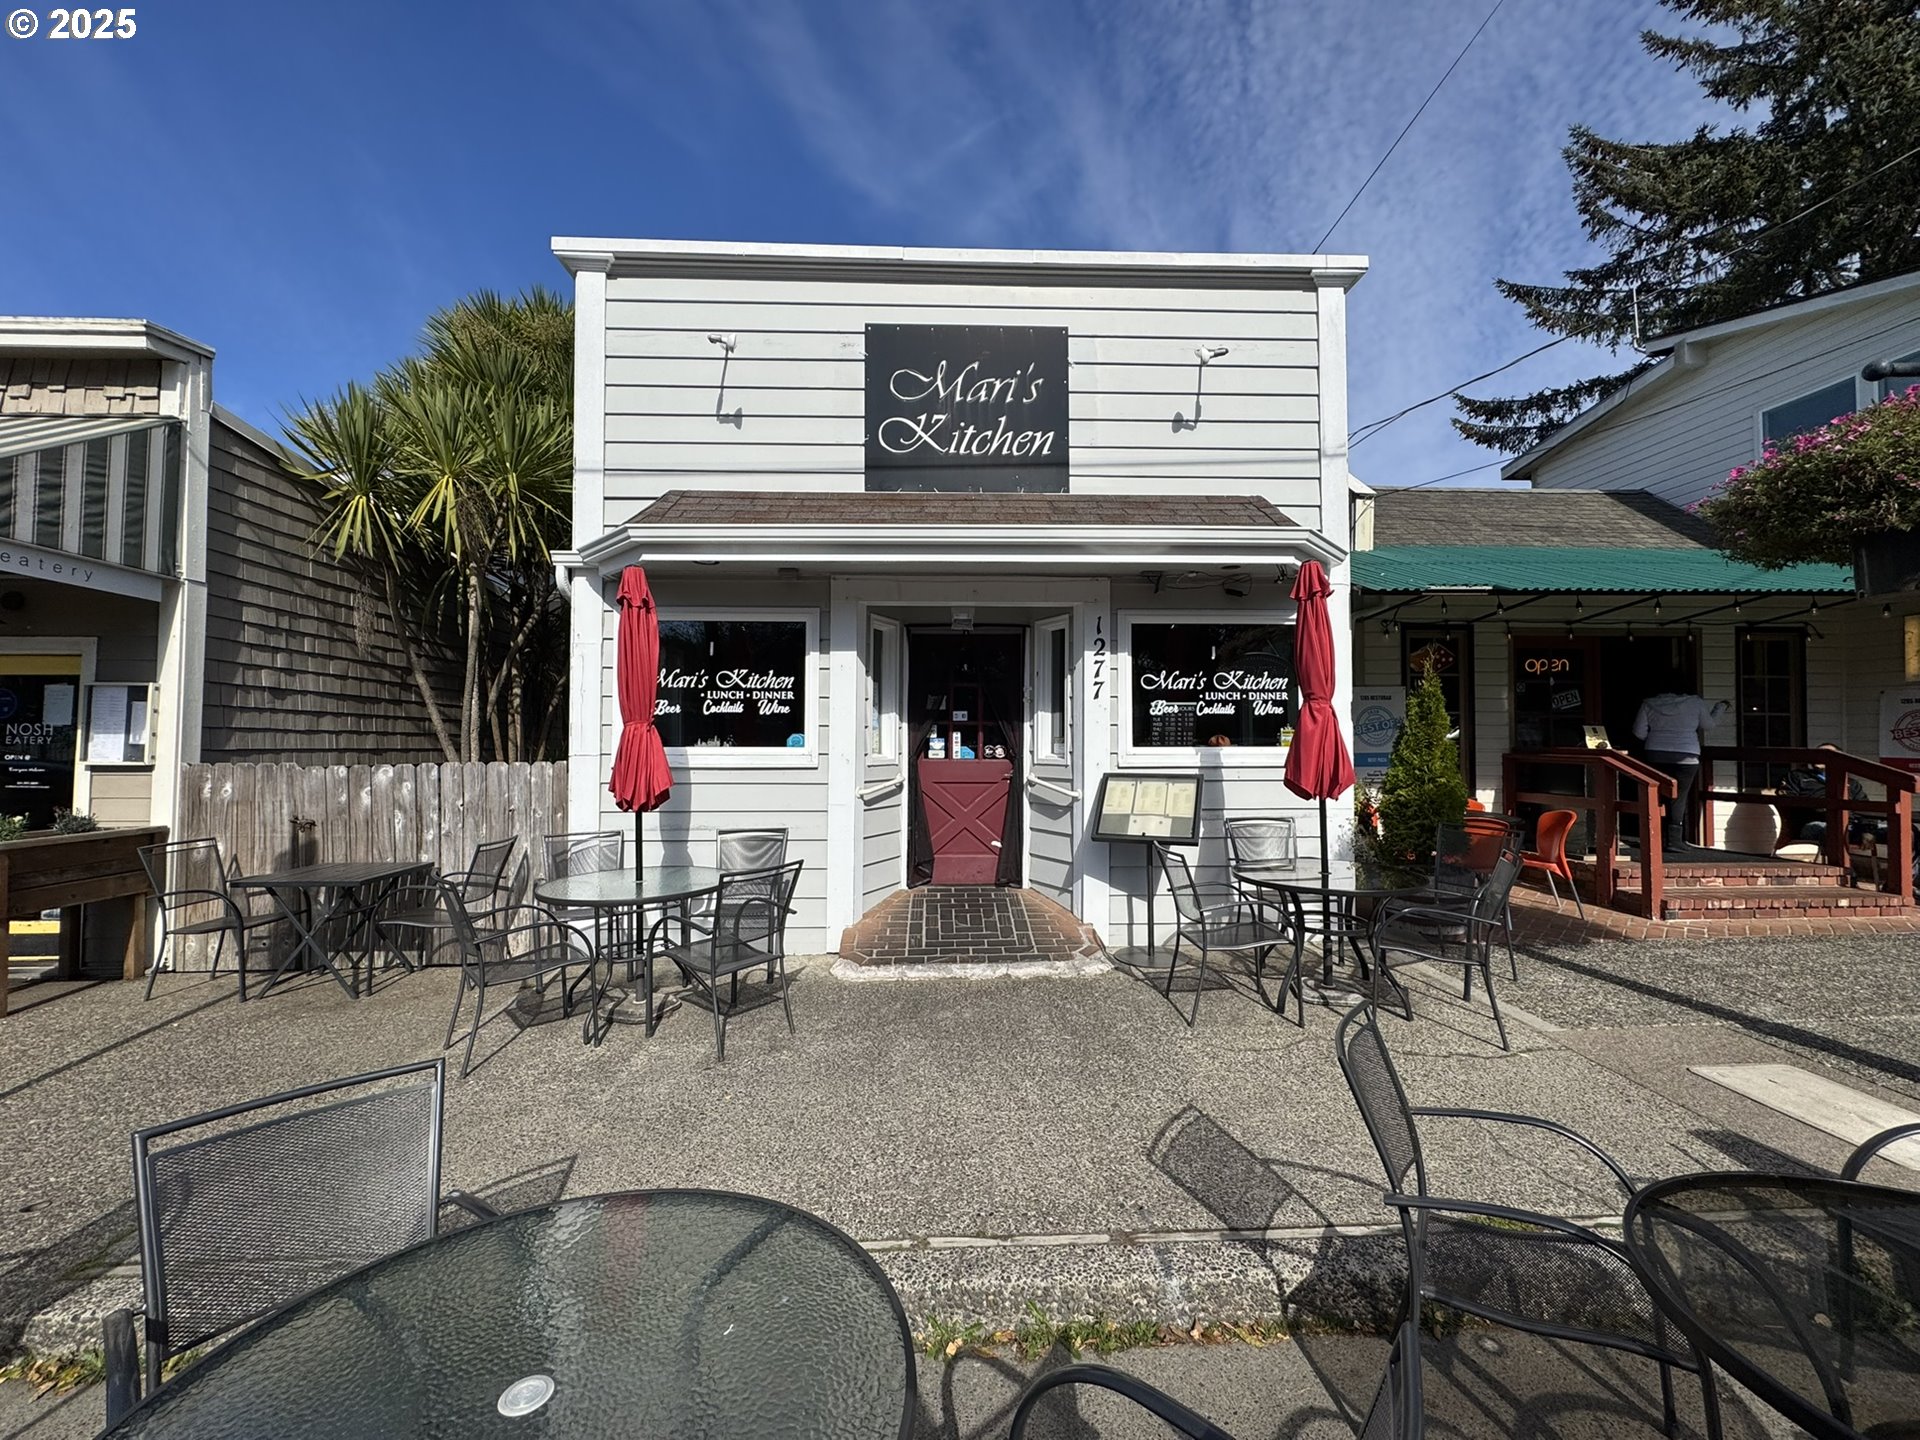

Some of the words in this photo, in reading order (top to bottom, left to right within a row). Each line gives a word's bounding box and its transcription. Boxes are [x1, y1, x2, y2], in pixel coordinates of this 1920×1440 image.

[889, 360, 1044, 403] Mari's
[878, 413, 1055, 456] Kitchen
[0, 551, 93, 582] eatery
[1093, 616, 1106, 700] 1277
[1525, 659, 1569, 675] open
[716, 669, 795, 689] Kitchen
[1140, 670, 1207, 690] Mari's
[1213, 670, 1288, 690] Kitchen
[707, 690, 744, 700] LUNCH
[752, 690, 795, 700] DINNER
[1205, 692, 1241, 700] LUNCH
[1249, 692, 1288, 700] DINNER
[1552, 691, 1578, 706] OPEN
[654, 700, 681, 715] Beer
[703, 700, 744, 715] Cocktails
[758, 700, 790, 715] Wine
[1150, 700, 1179, 716] Beer
[1196, 700, 1235, 716] Cocktails
[1253, 700, 1284, 715] Wine
[6, 723, 53, 736] NOSH
[1356, 722, 1380, 735] BEST
[1895, 728, 1920, 739] BES
[5, 736, 52, 744] EATERY
